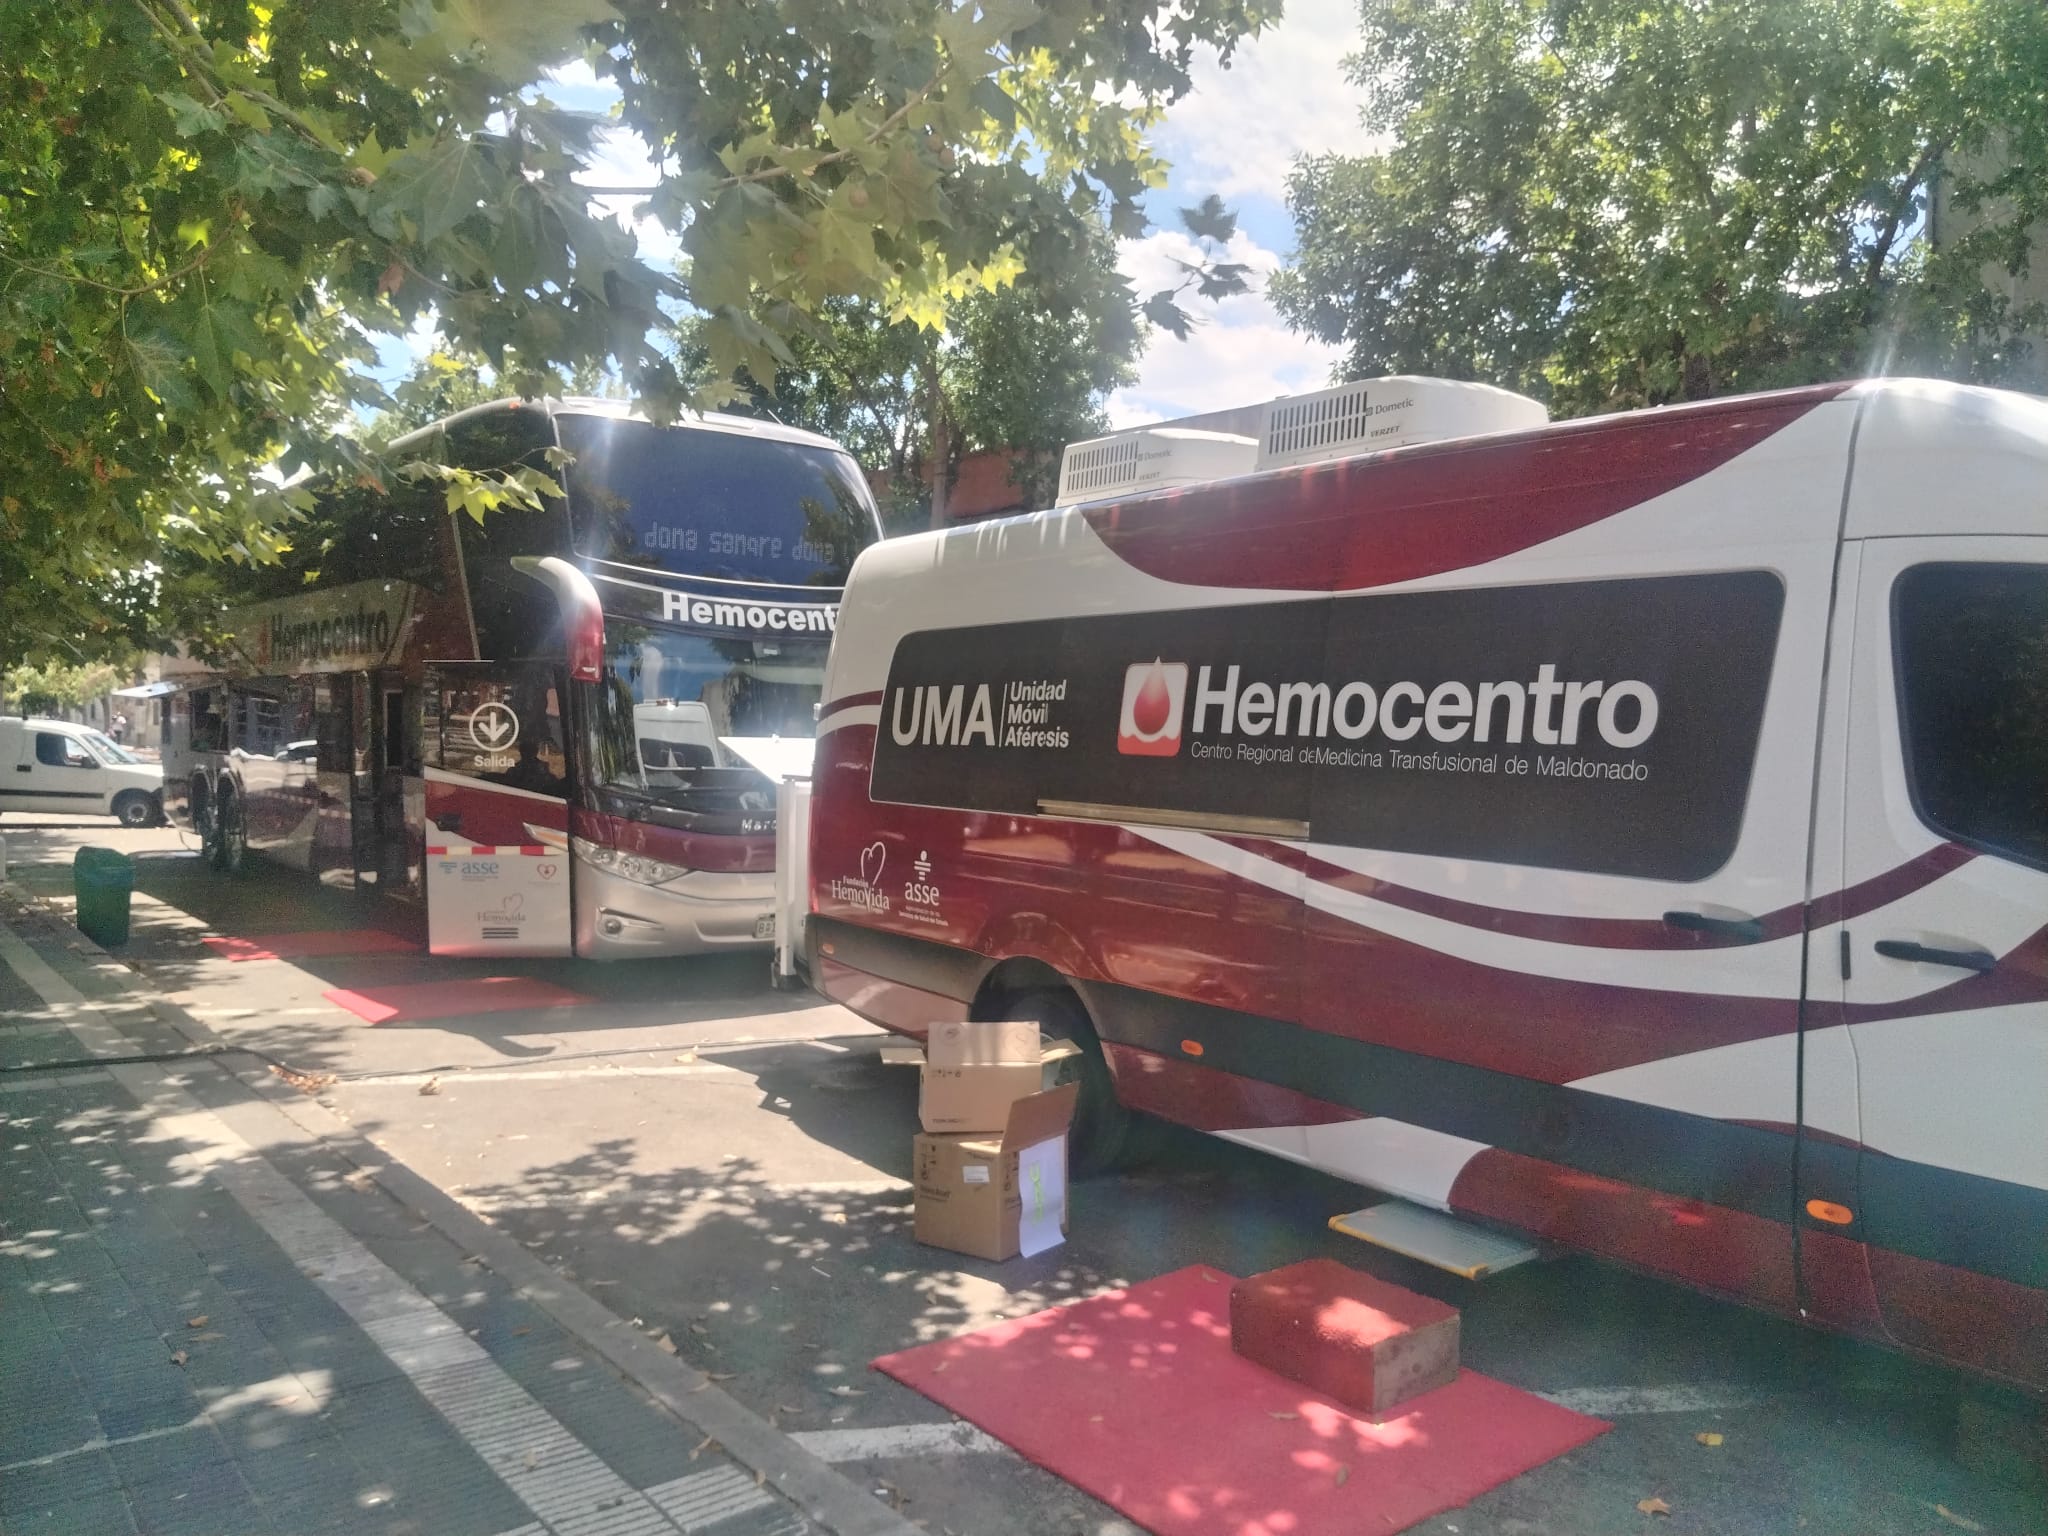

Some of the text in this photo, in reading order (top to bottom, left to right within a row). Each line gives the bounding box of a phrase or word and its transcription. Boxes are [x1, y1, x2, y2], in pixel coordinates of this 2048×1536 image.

[1376, 398, 1415, 415] Dometic
[644, 521, 698, 551] dona
[662, 591, 840, 632] Hemocent
[1010, 679, 1067, 702] Unidad
[891, 683, 996, 746] UMA
[1007, 703, 1049, 725] Móvil
[1192, 663, 1660, 749] Hemocentro
[1004, 725, 1070, 749] Aféresis
[474, 754, 516, 768] Salida
[1191, 741, 1233, 760] Centro
[1237, 743, 1294, 766] Regional
[1315, 746, 1383, 768] Medicina
[1389, 749, 1498, 774] Transfusional
[1504, 754, 1529, 775] de
[1536, 755, 1649, 781] Maldonado
[461, 861, 499, 875] asse
[831, 879, 890, 912] HemoVida
[904, 881, 940, 907] asse
